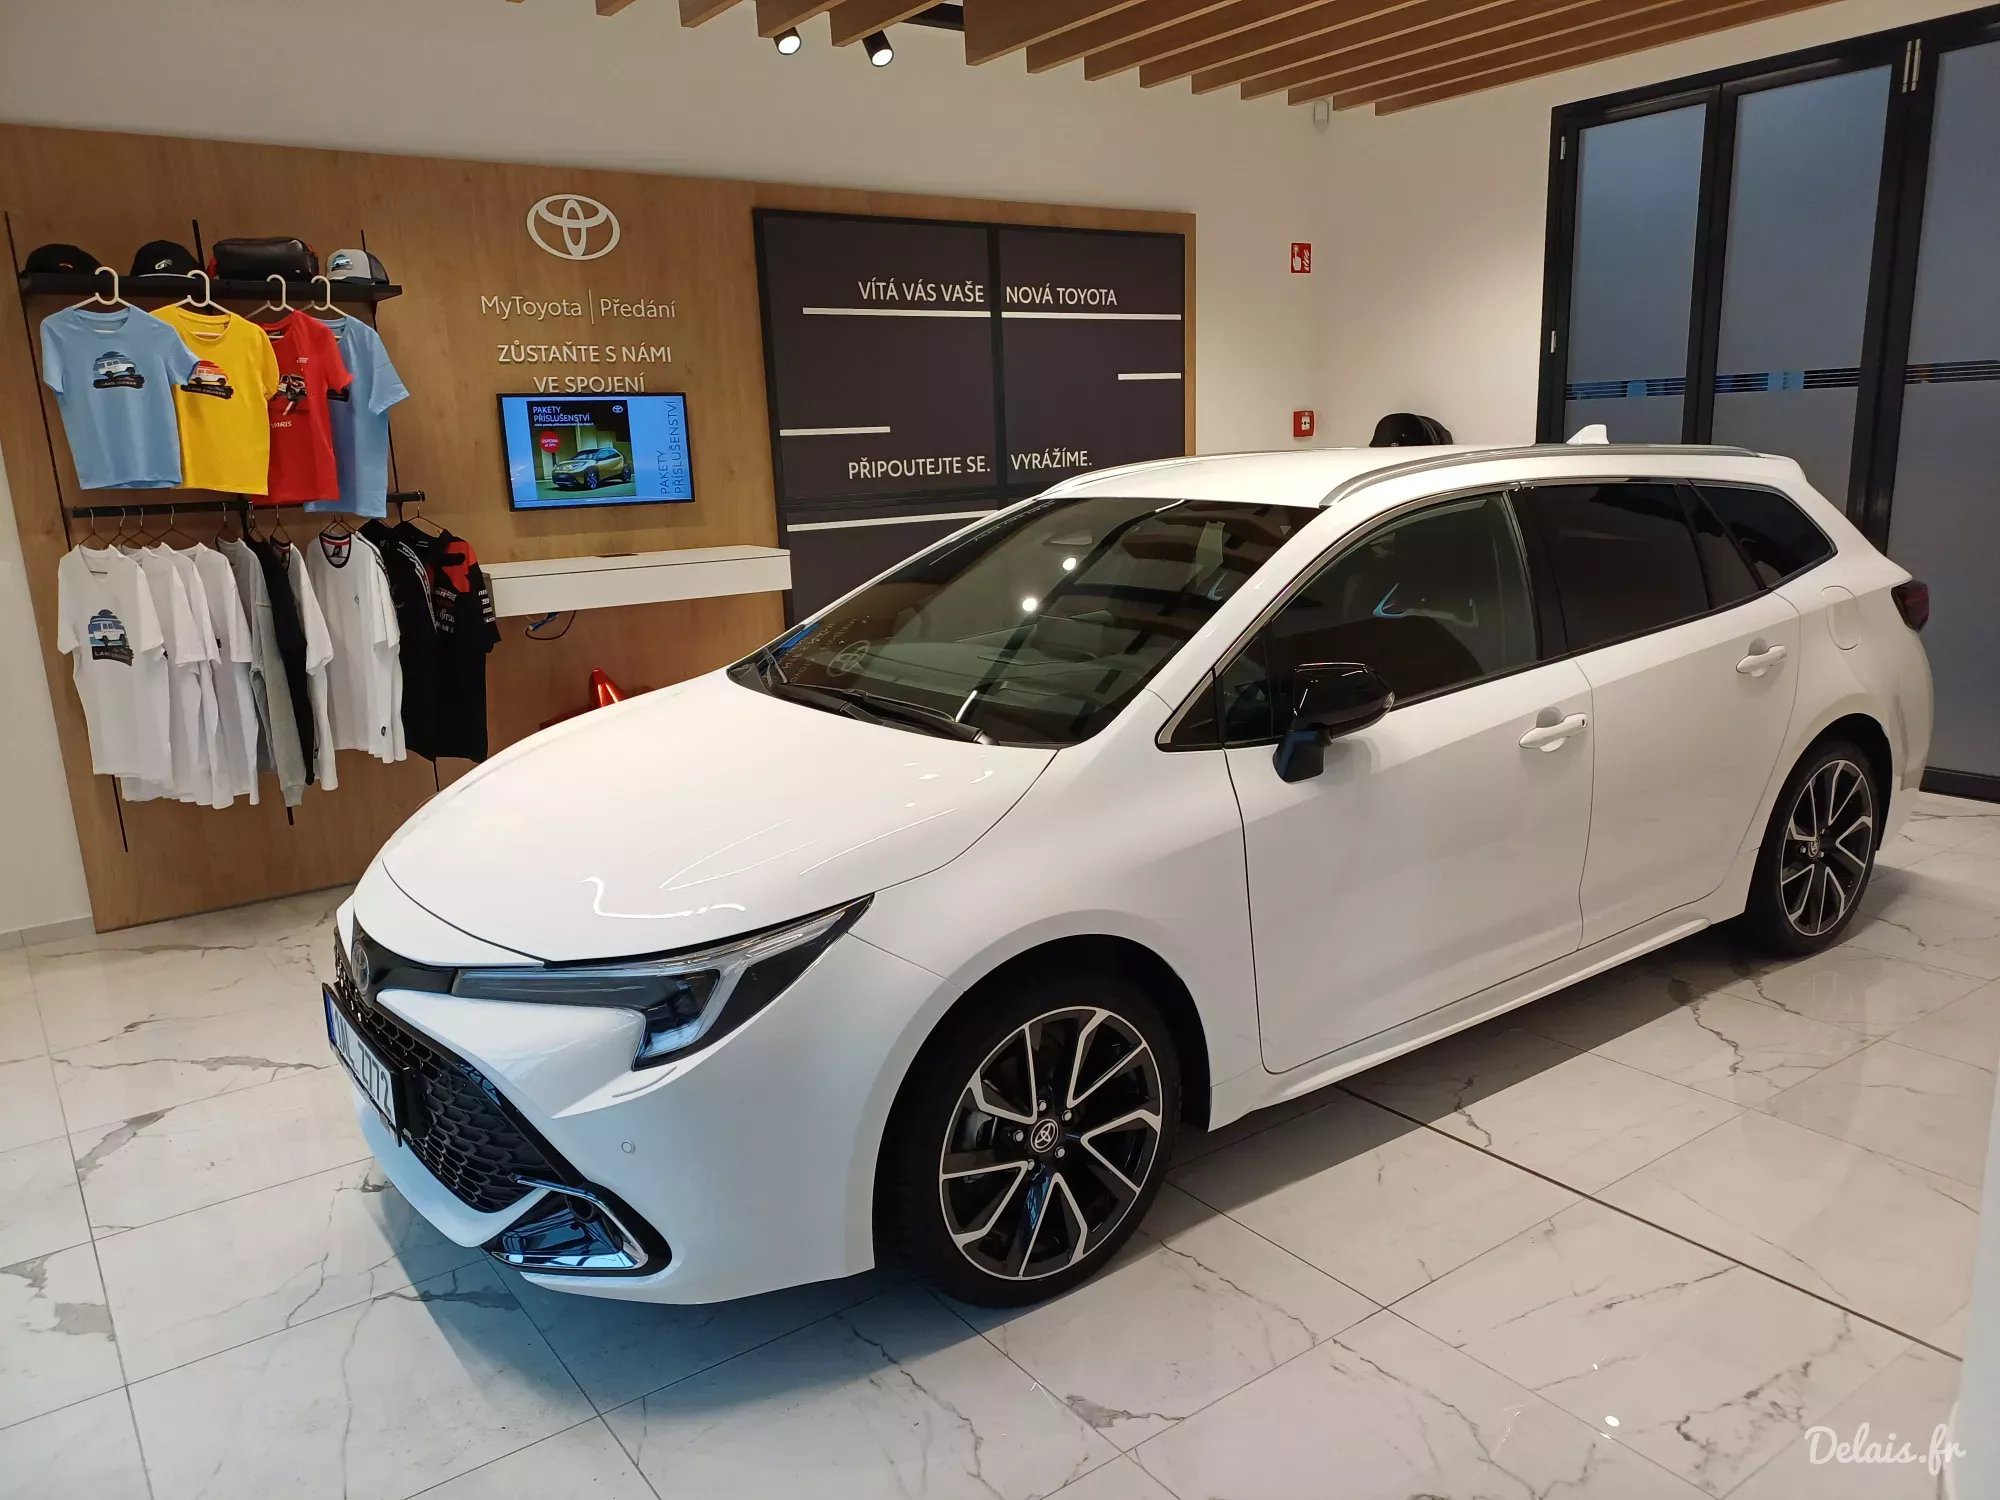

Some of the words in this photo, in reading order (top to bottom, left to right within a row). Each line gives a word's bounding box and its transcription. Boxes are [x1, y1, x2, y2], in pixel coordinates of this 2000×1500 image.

[858, 277, 899, 300] VÍTÁ
[902, 279, 937, 302] VÁS
[940, 281, 984, 303] VAŠE
[1006, 283, 1053, 304] NOVÁ
[1056, 287, 1118, 306] TOYOTA
[481, 296, 582, 320] MyToyota
[600, 298, 676, 318] Předání
[497, 340, 600, 362] ZŮSTAŇTE
[606, 345, 617, 363] S
[622, 341, 672, 363] NÁMI
[533, 376, 559, 393] VE
[565, 372, 645, 393] SPOJENÍ
[533, 406, 561, 414] PAKETY
[534, 413, 590, 422] PŘÍSLUŠENSTVÍ
[664, 400, 685, 495] PŘÍSLUŠENSTVÍ
[656, 450, 671, 495] PAKETY
[848, 457, 962, 479] PŘIPOUTEJTE
[966, 456, 991, 473] SE.
[1011, 447, 1093, 470] VYRÁŽÍME.
